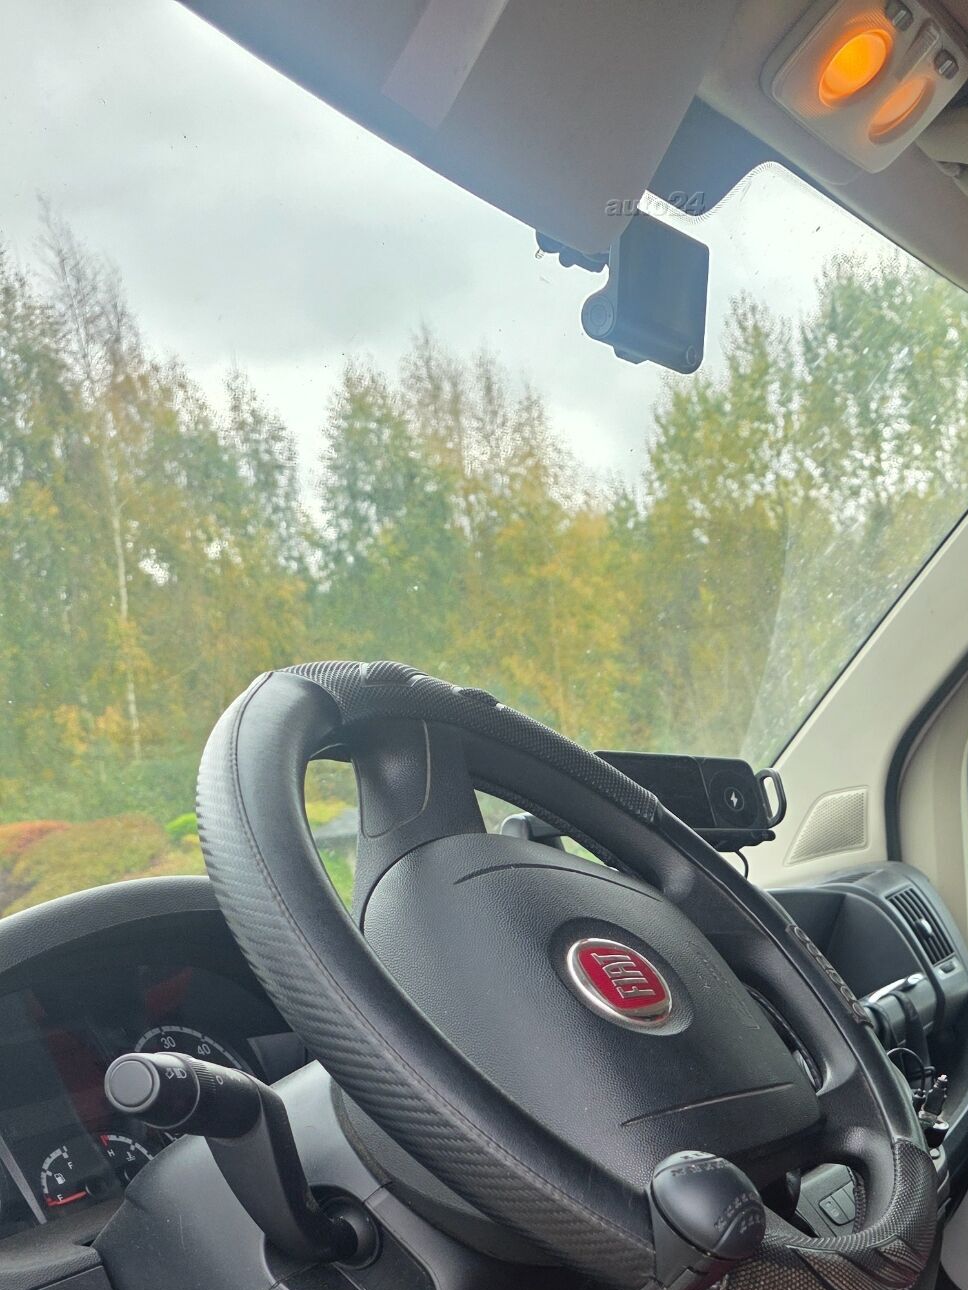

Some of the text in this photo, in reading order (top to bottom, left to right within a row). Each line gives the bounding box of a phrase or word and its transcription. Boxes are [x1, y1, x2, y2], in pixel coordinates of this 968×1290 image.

[590, 952, 657, 999] FIAT
[160, 1035, 176, 1049] 30
[197, 1043, 211, 1056] 40
[107, 1149, 115, 1157] H
[67, 1161, 73, 1170] F
